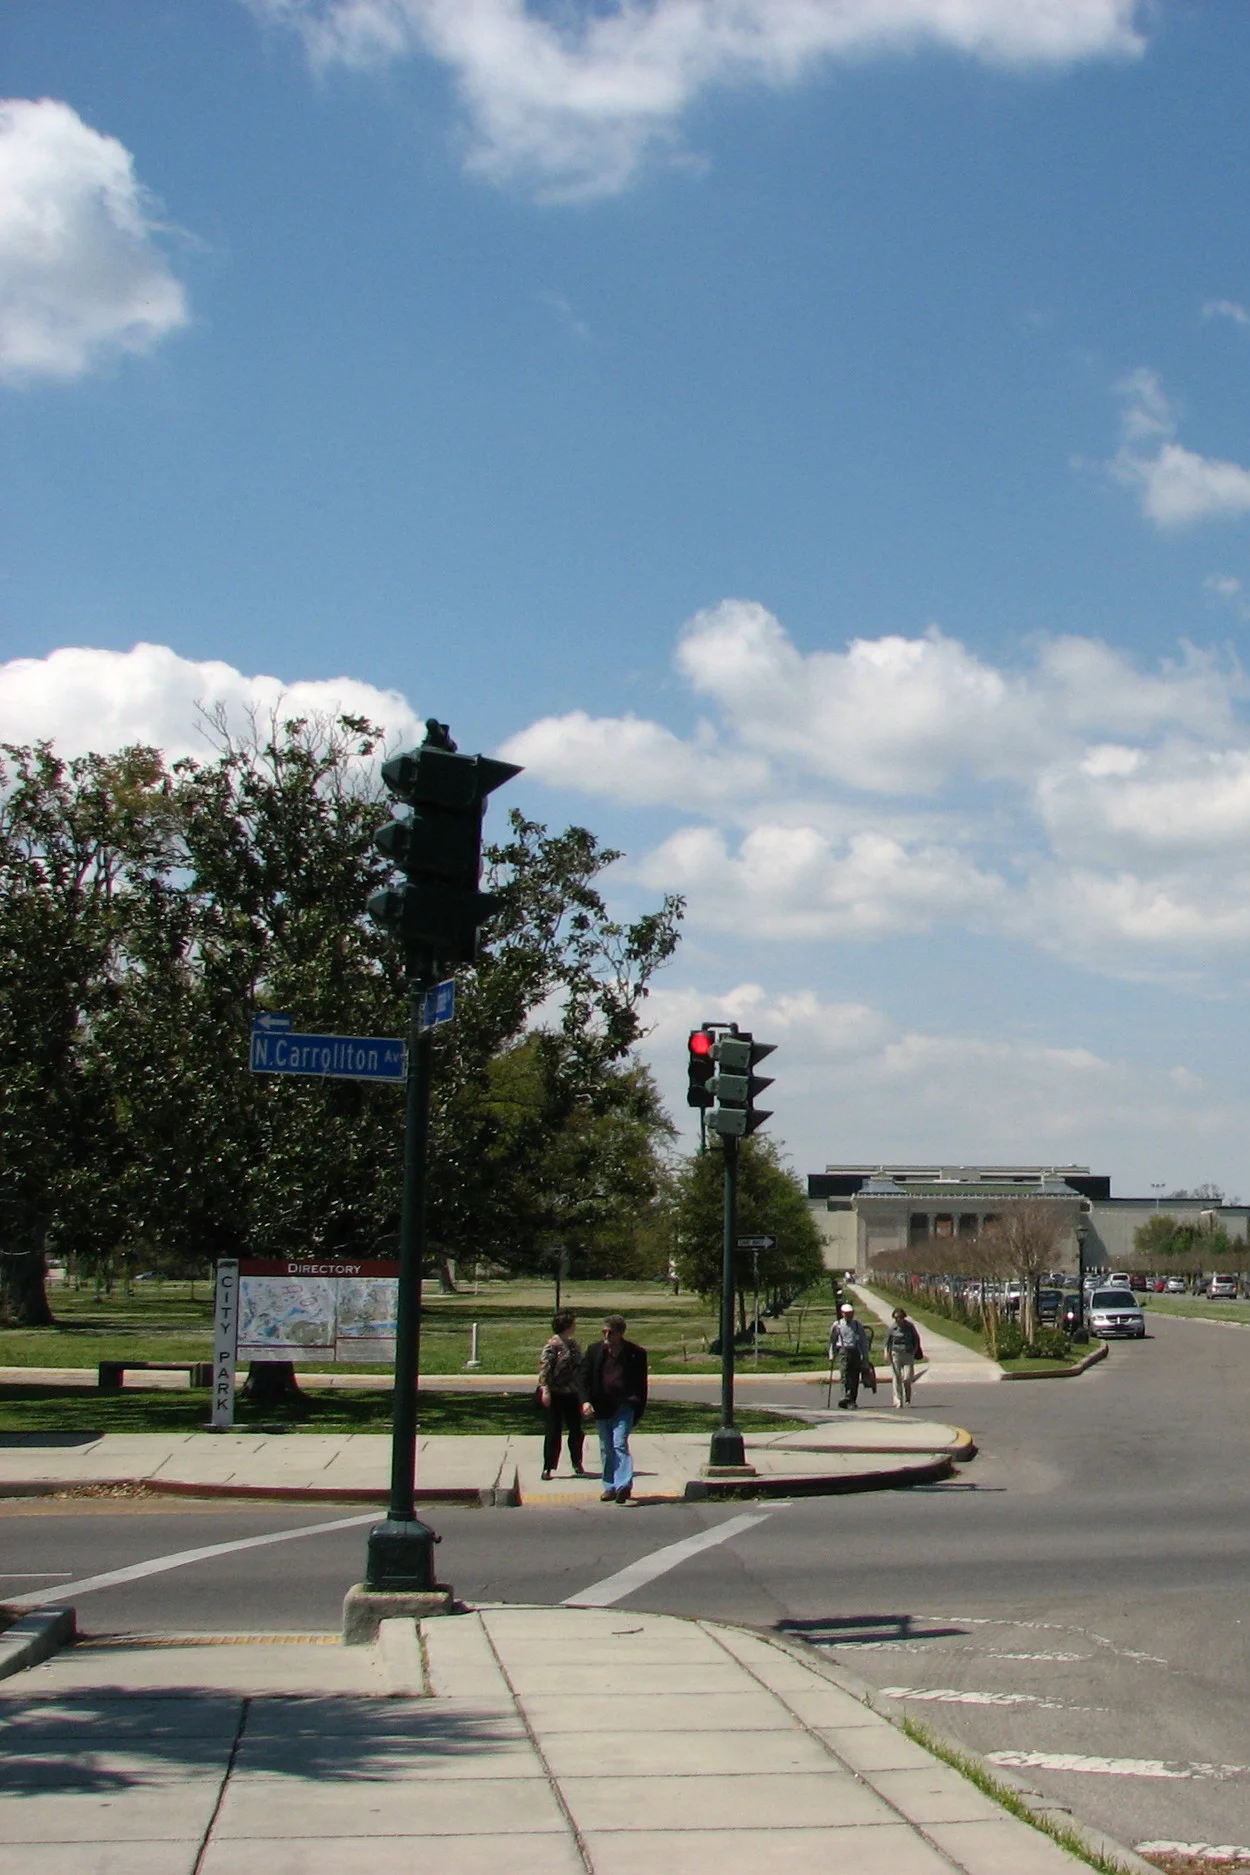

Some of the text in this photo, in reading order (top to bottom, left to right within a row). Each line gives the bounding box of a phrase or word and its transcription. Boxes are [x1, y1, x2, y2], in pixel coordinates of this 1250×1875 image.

[287, 1263, 361, 1274] DIRECTORY
[217, 1276, 233, 1411] CITY PARK
